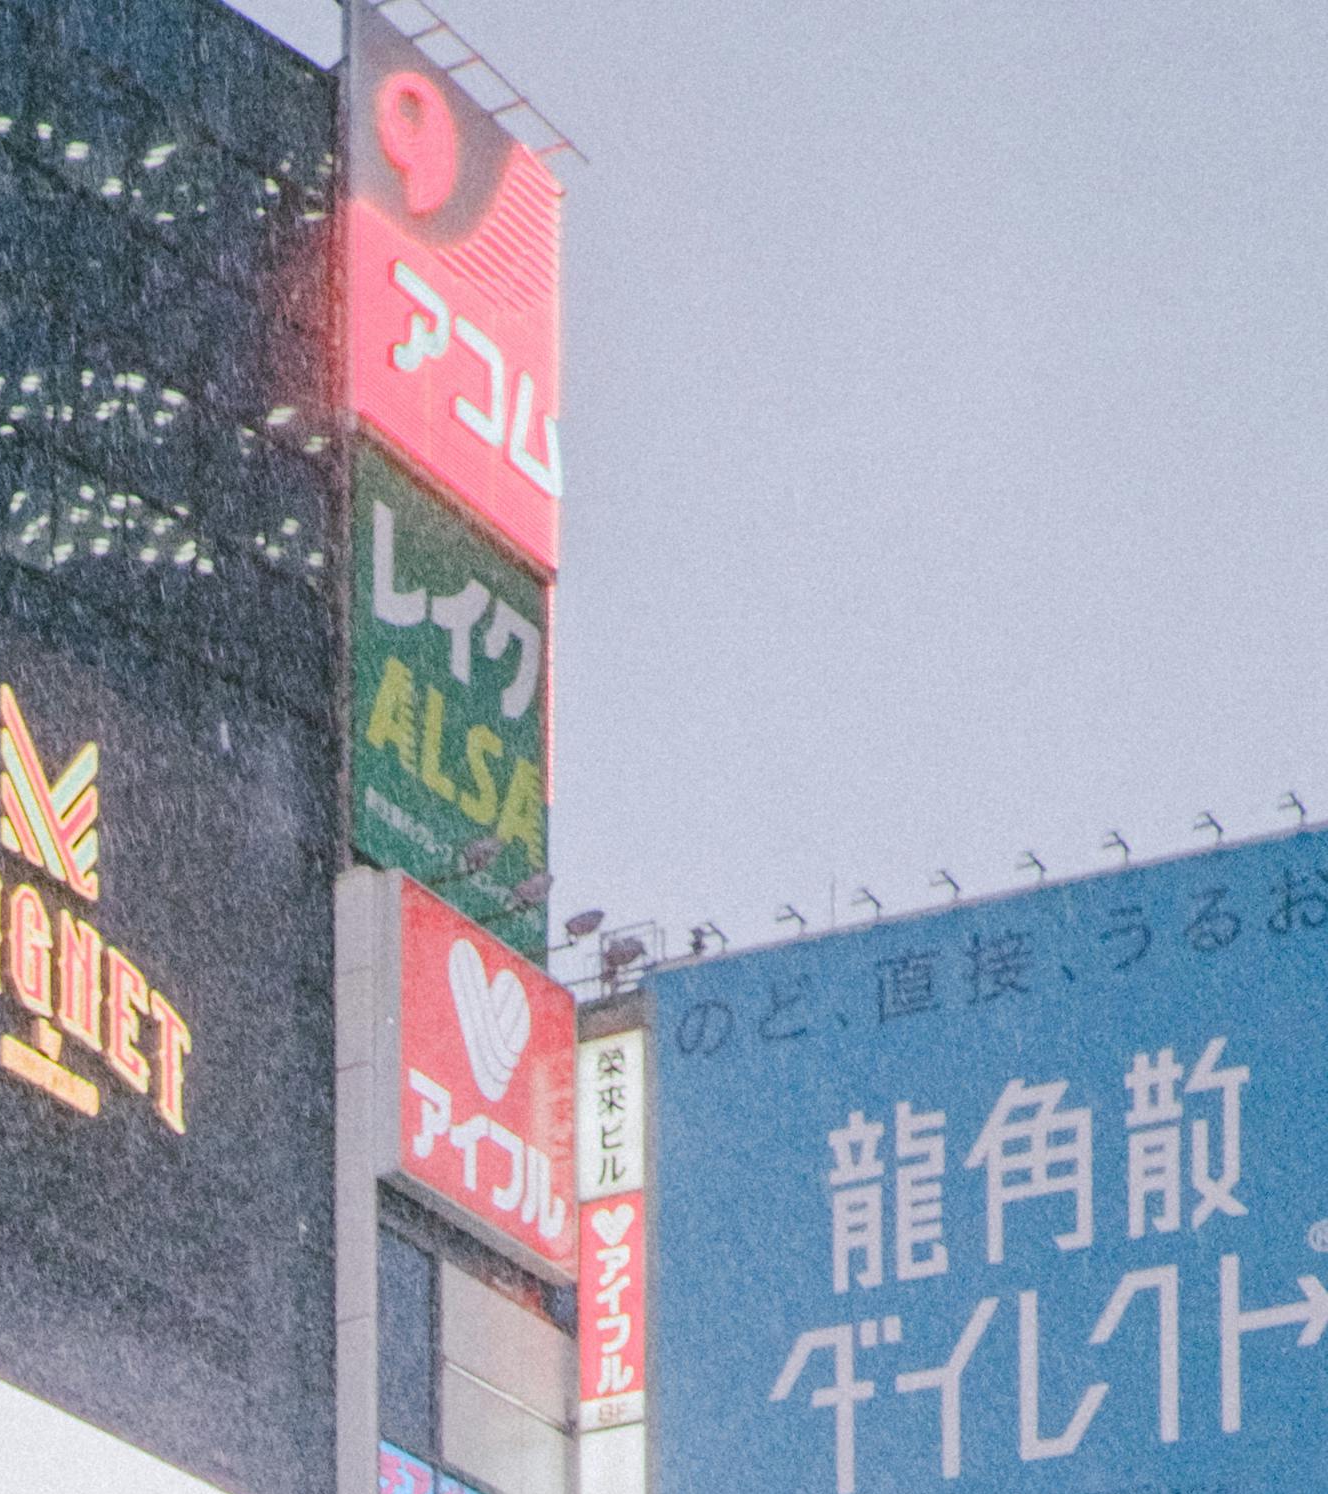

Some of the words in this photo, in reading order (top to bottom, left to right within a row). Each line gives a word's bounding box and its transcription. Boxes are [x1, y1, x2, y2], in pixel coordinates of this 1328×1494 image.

[391, 259, 562, 498] アコム
[372, 500, 542, 721] レイク
[365, 656, 543, 867] ALSA
[408, 1067, 566, 1238] アイフル
[828, 1036, 1251, 1295] 龍角散
[596, 1244, 634, 1394] アイフル
